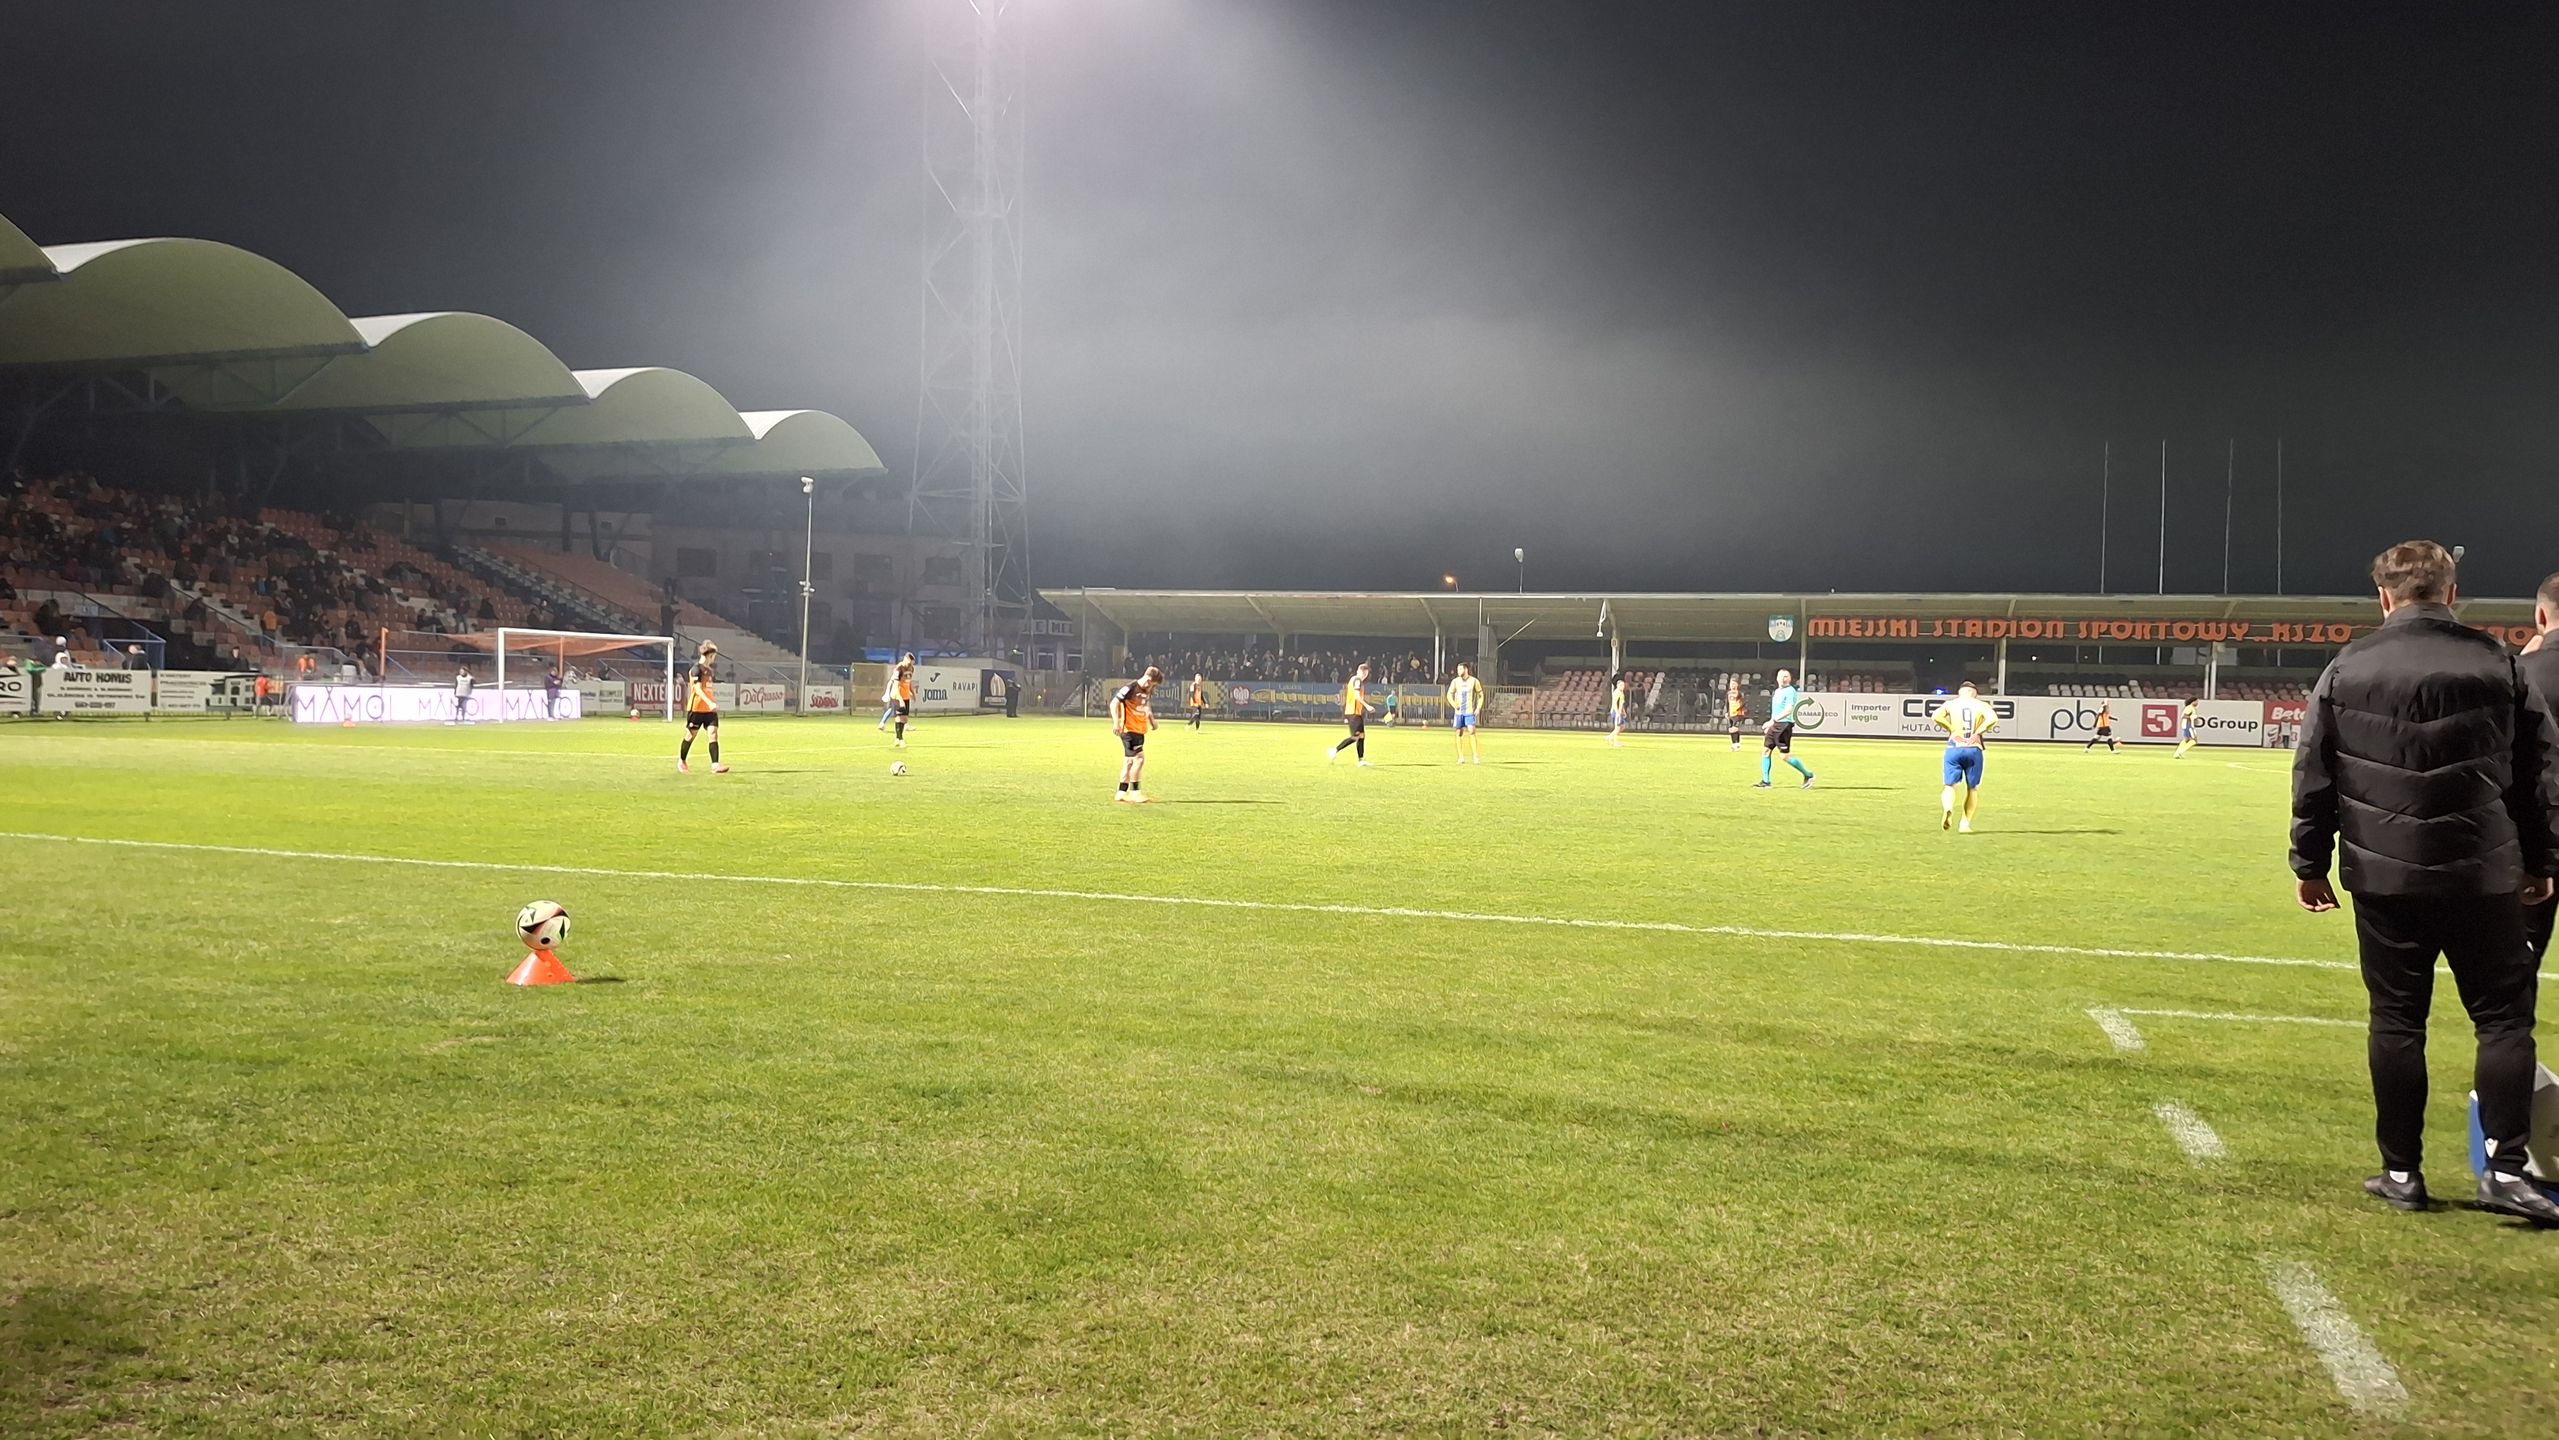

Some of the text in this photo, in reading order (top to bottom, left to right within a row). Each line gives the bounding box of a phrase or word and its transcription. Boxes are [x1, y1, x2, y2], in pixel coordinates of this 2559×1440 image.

[1807, 617, 1919, 638] MIEJSKI
[1932, 618, 2065, 640] STADION
[2078, 619, 2250, 642] SPORTOWY
[64, 671, 92, 682] AUTO
[1851, 703, 1891, 712] Importer
[1851, 713, 1878, 722] węgla
[1902, 723, 1931, 733] HUTA
